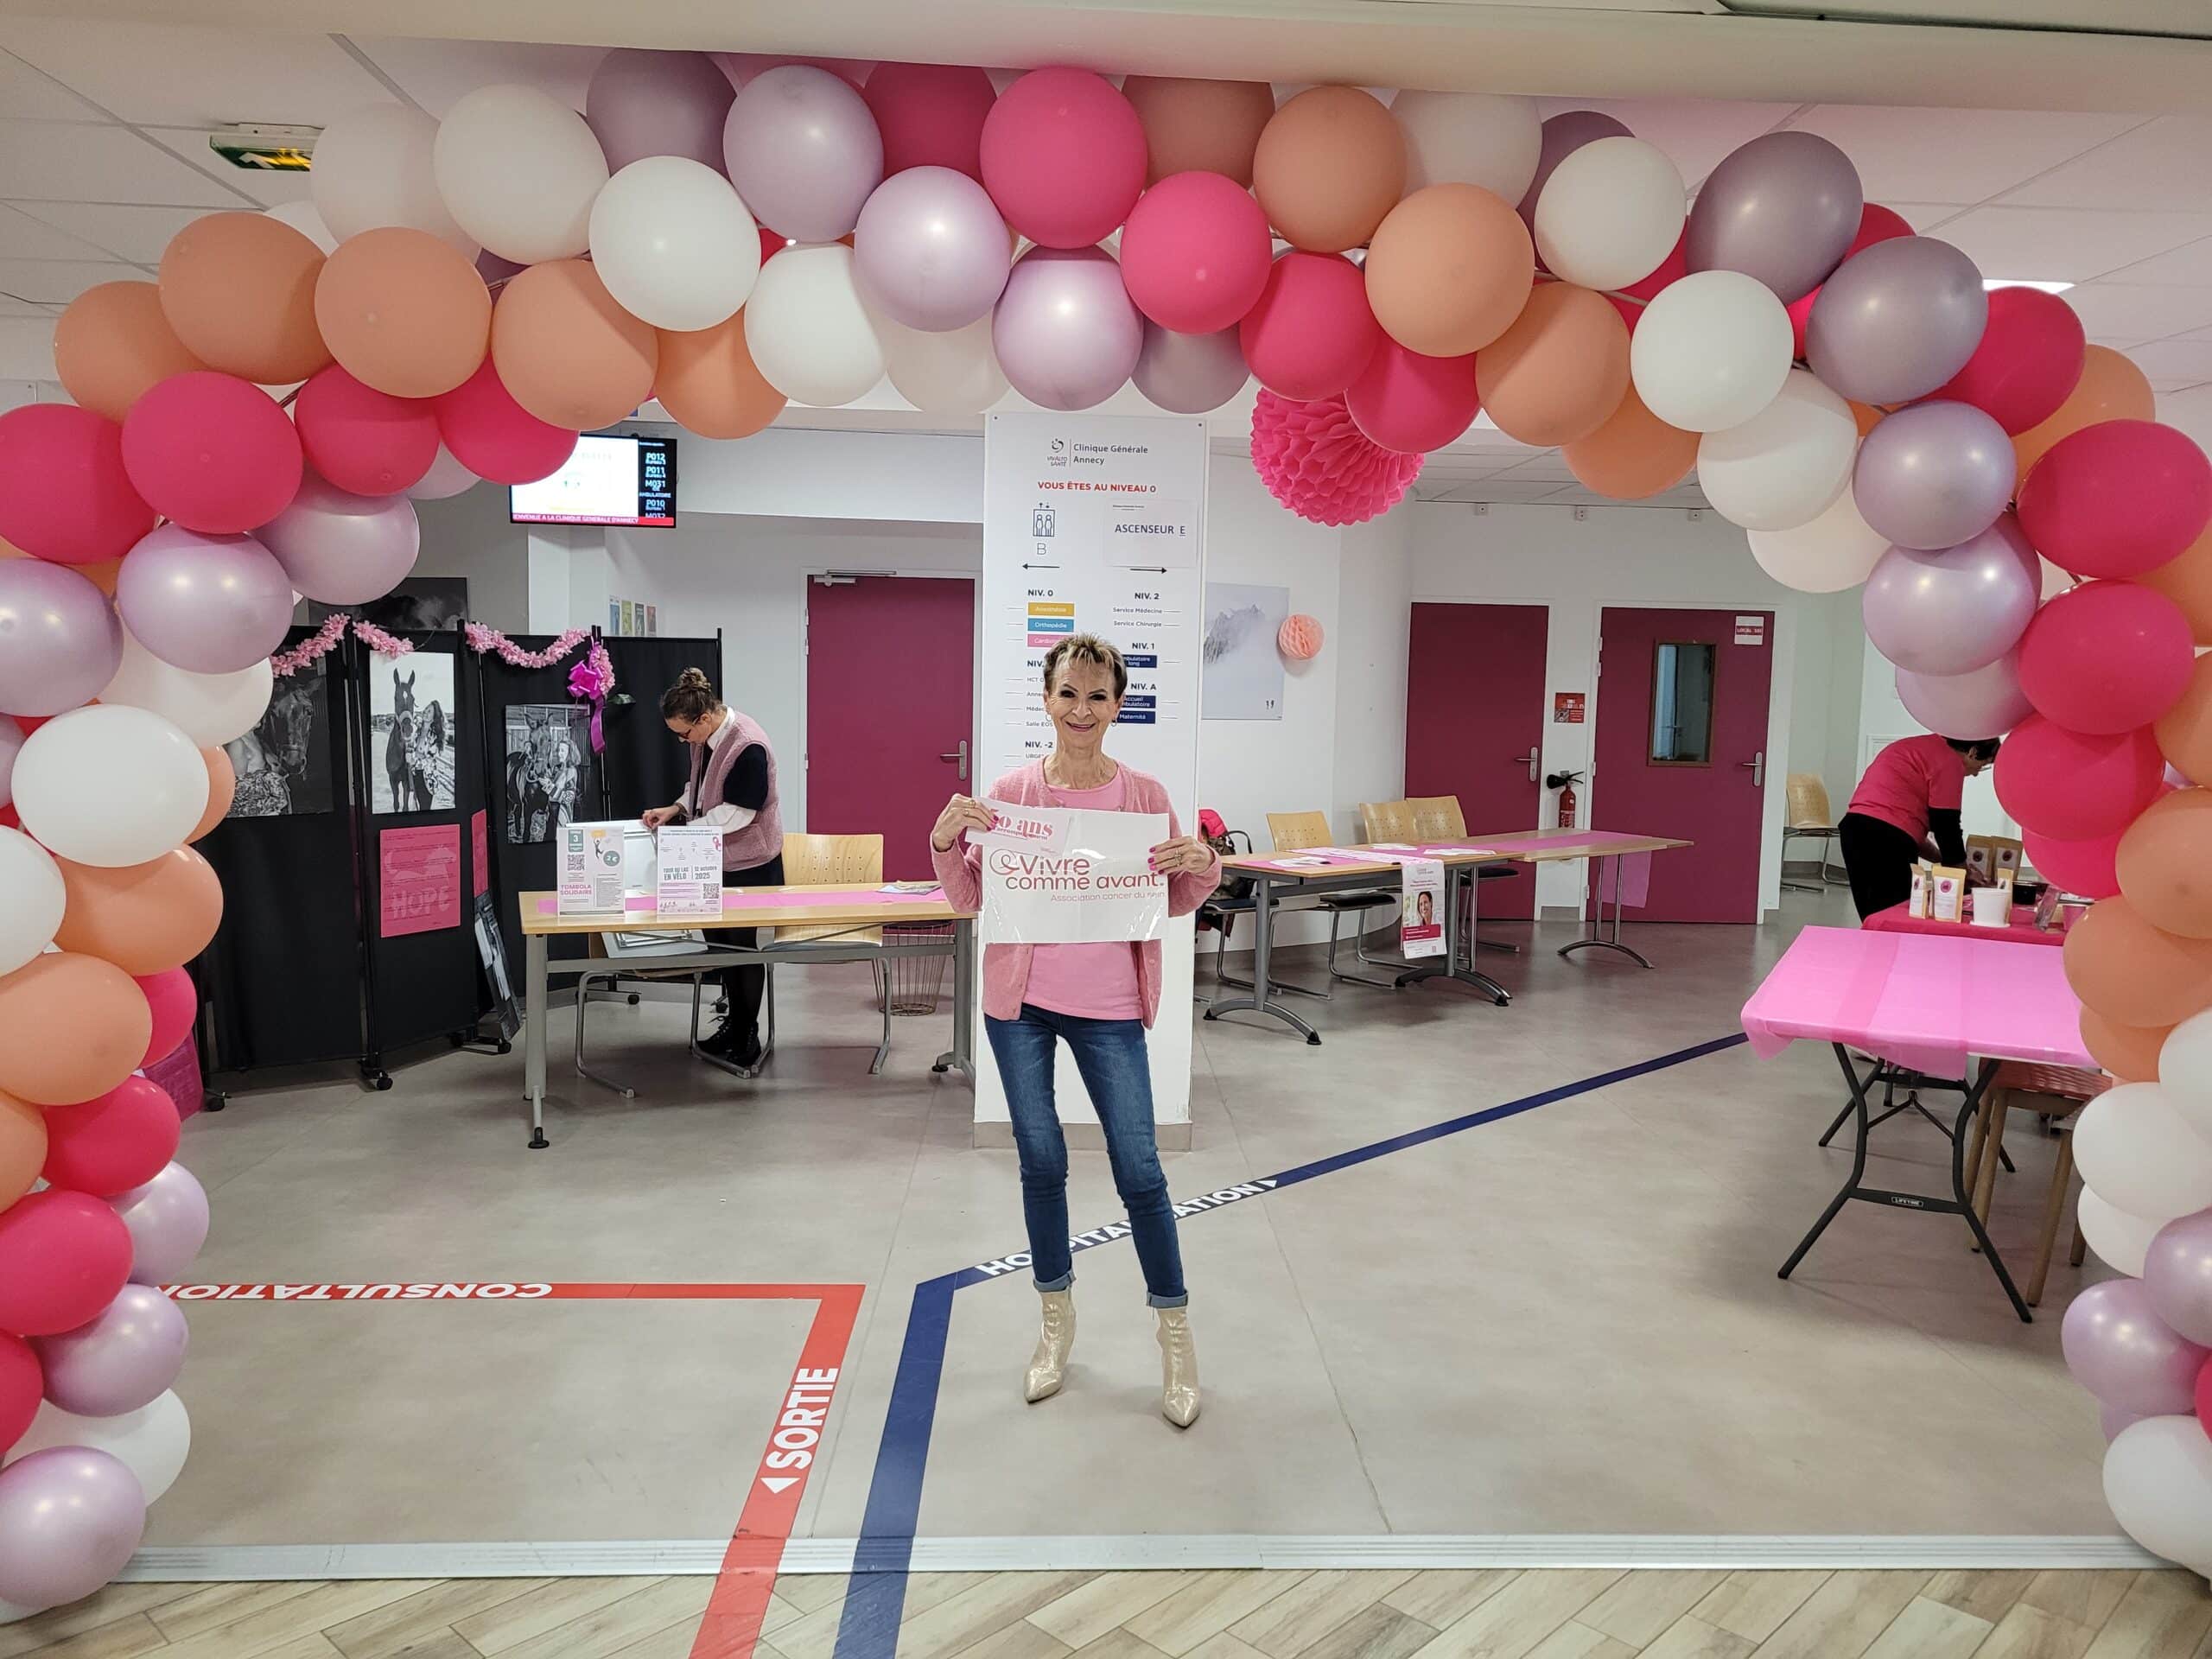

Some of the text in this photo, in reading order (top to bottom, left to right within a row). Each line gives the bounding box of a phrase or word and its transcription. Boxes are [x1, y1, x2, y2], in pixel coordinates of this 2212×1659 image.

[1073, 443, 1148, 454] Clinique Générale
[645, 452, 665, 461] P012
[1073, 455, 1105, 465] Annecy
[645, 466, 665, 474] P011
[1038, 481, 1065, 490] VOUS
[1066, 480, 1091, 491] ÊTES
[1093, 483, 1108, 492] AU
[1110, 483, 1147, 493] NIVEAU
[645, 499, 665, 508] P010
[1115, 524, 1186, 537] ASCENSEUR E
[1037, 543, 1046, 556] B
[1016, 819, 1053, 839] ans
[1019, 854, 1090, 876] Vivre
[1005, 876, 1090, 890] comme
[1051, 893, 1101, 902] Association
[1134, 891, 1146, 899] du
[766, 1368, 839, 1470] SORTIE
